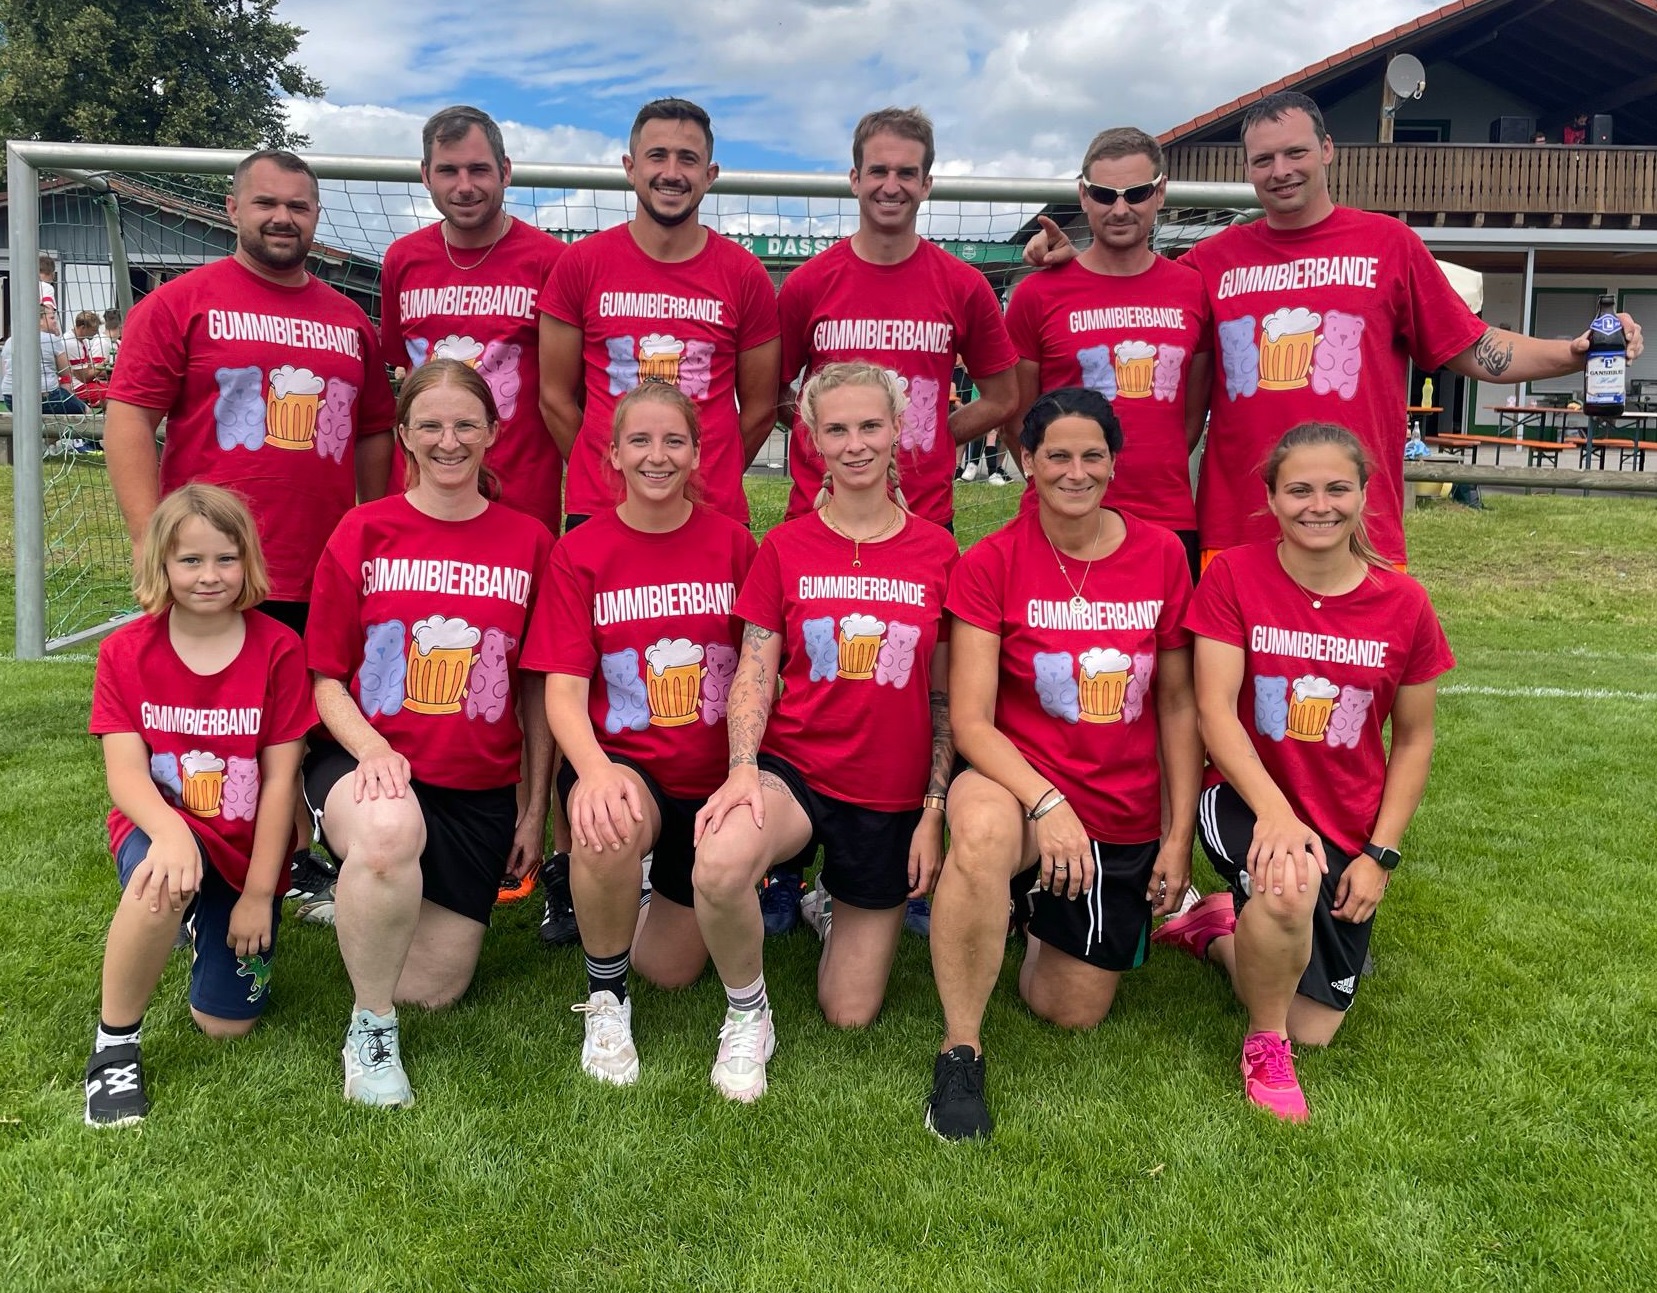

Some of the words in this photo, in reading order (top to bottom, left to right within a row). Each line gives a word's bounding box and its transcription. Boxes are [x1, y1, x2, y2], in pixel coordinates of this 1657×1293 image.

[767, 237, 840, 256] DASS
[1217, 256, 1379, 301] GUMMIBIERBANDE
[599, 292, 724, 325] GUMMIBIERBANDE
[1069, 306, 1187, 334] GUMMIBIERBANDE
[813, 319, 954, 354] GUMMIBIERBANDE
[593, 582, 737, 627] UMMIBIERBAND
[799, 575, 926, 608] GUMMIBIERBANDE
[1027, 598, 1165, 631] GUMMIBIERBAND
[1251, 624, 1390, 669] GUMMIBIERBANDE
[140, 701, 263, 736] GUMMIBIERBAND
